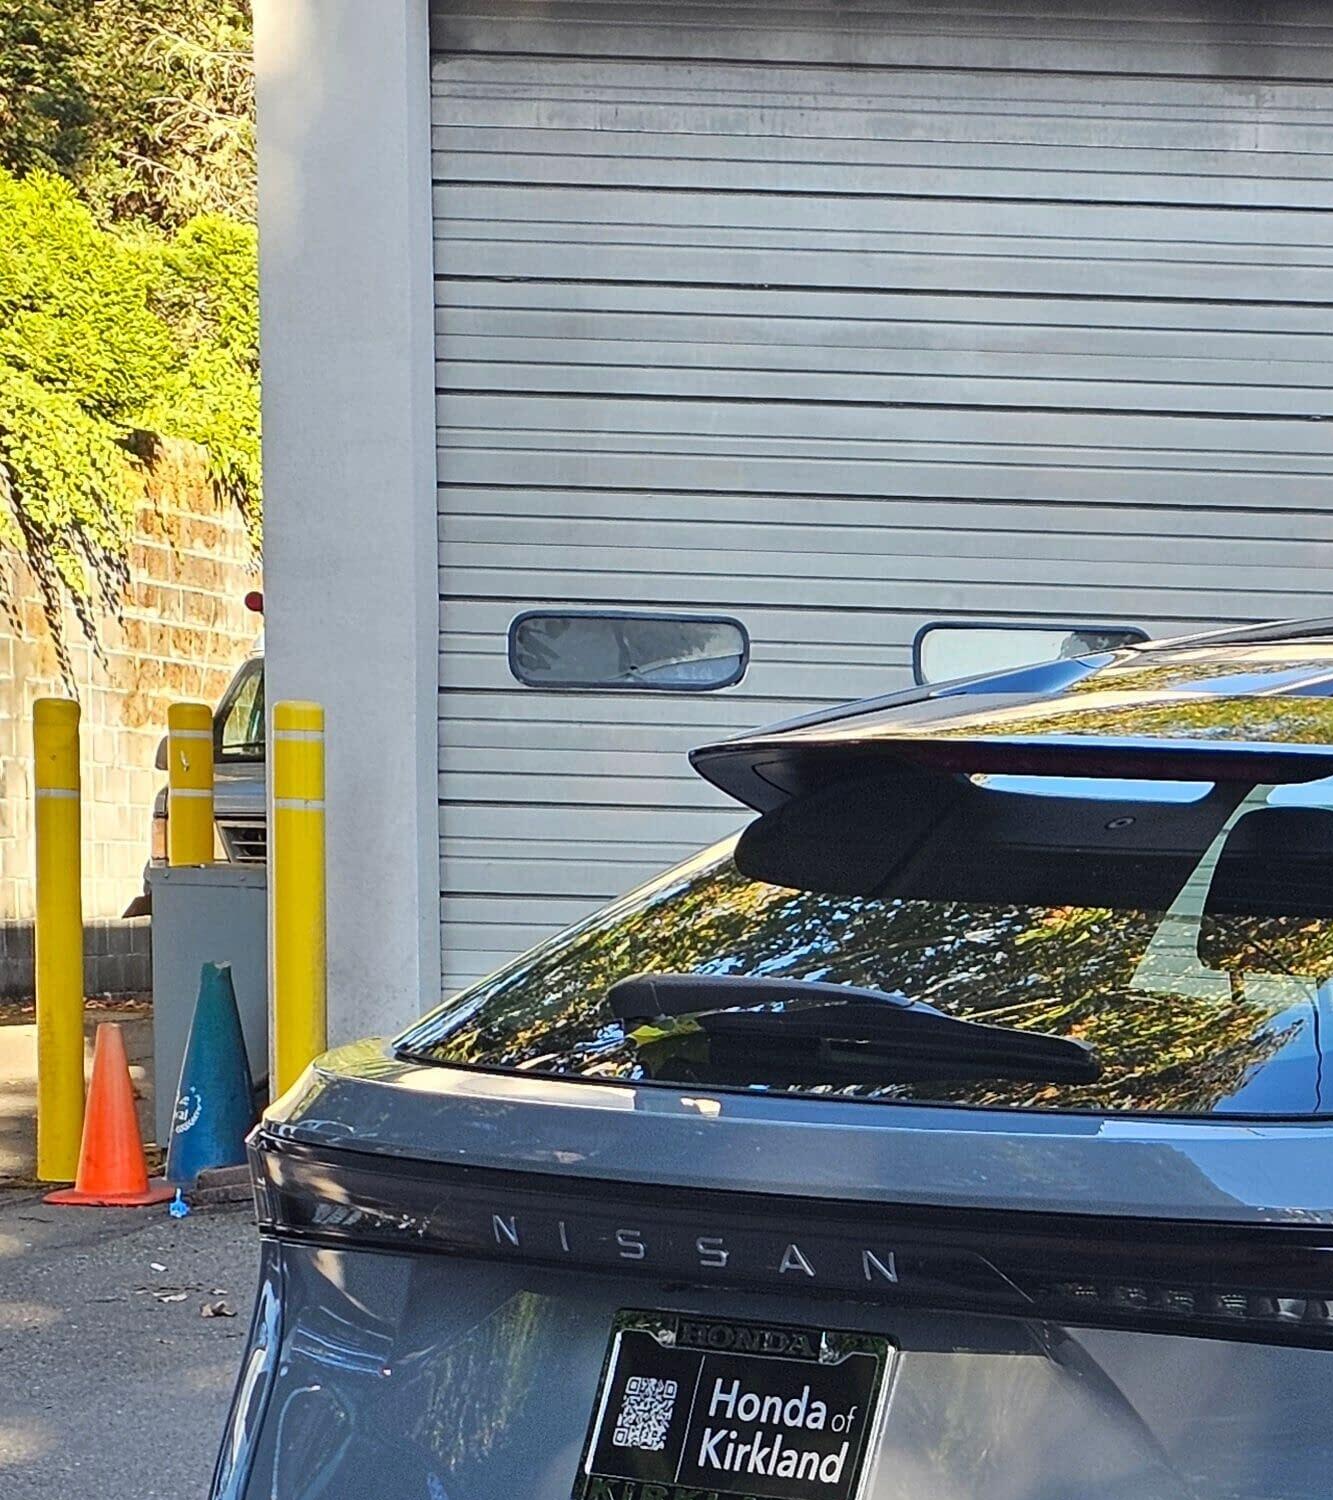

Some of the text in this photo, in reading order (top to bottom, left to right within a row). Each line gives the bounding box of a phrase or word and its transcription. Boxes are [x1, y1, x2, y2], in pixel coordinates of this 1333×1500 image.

[492, 1214, 899, 1283] NISSAN
[681, 1324, 812, 1351] HONDA
[708, 1378, 858, 1433] Honda of
[698, 1428, 850, 1484] Kirkland
